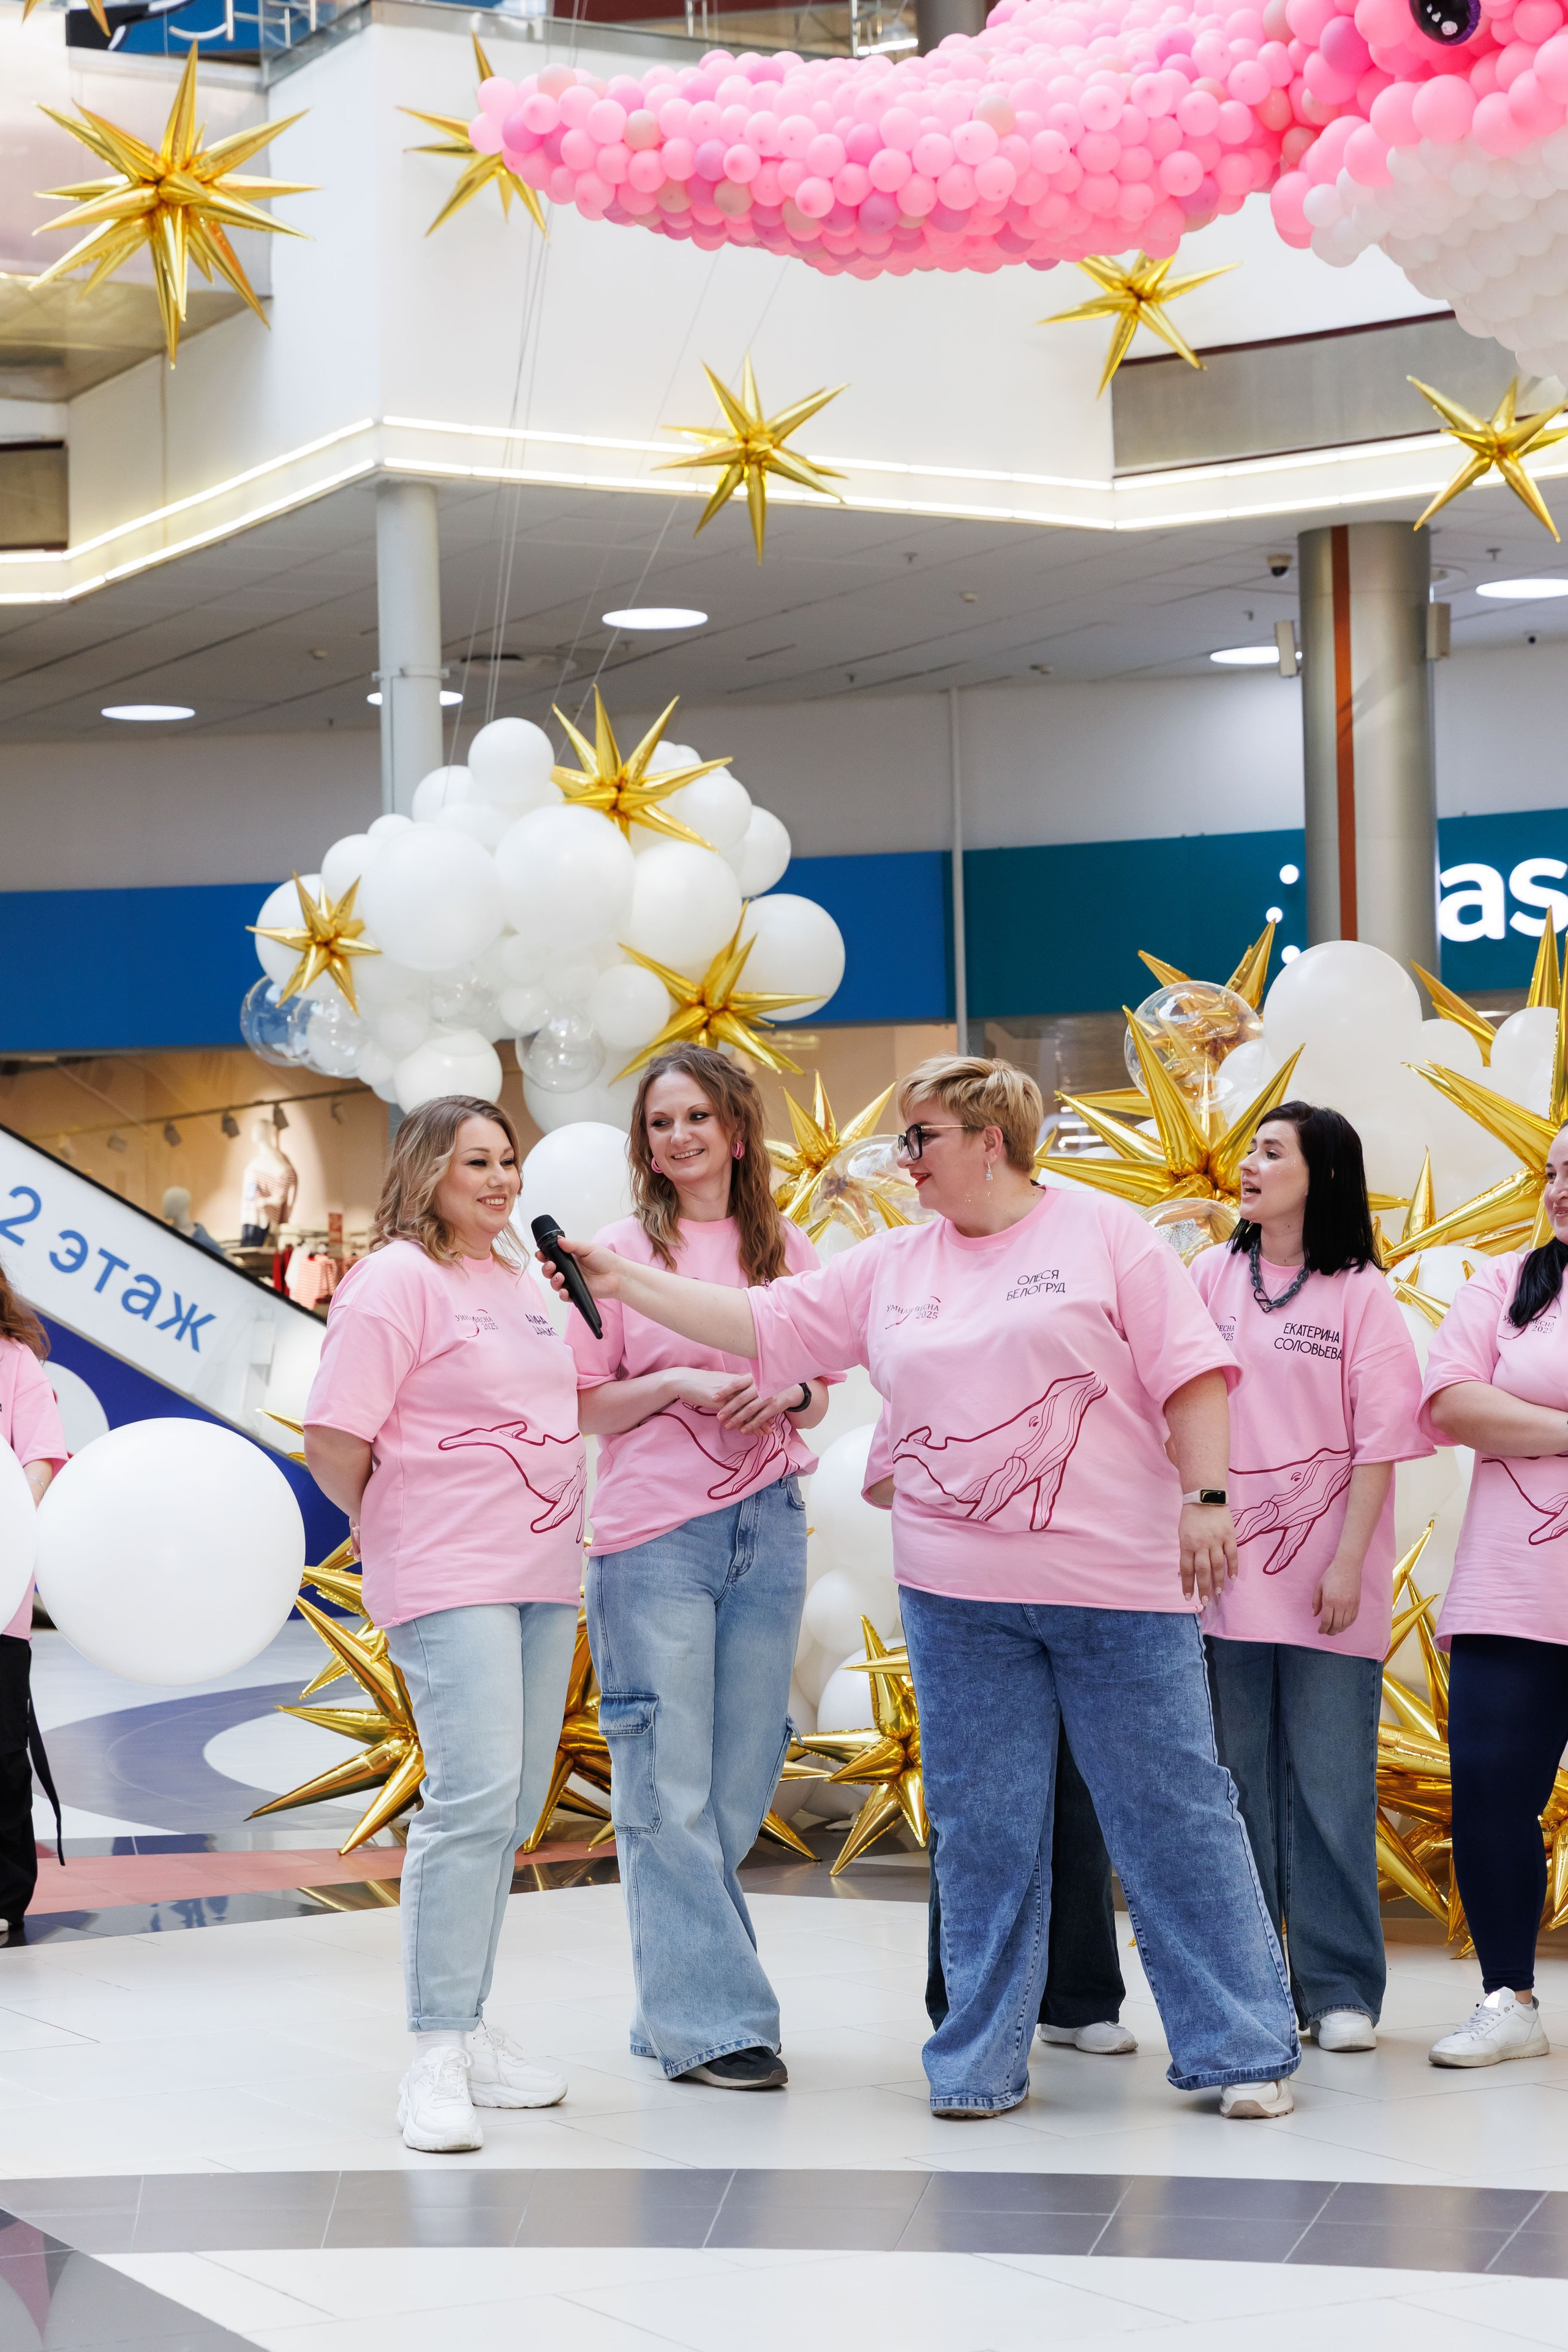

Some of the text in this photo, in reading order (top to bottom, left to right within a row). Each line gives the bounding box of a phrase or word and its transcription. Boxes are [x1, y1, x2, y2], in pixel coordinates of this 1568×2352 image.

[0, 1186, 217, 1352] 2 этаж
[1017, 1270, 1059, 1285] ОЛЕСЯ
[1006, 1283, 1066, 1301] БЕЛОГРУД
[916, 1311, 938, 1319] 2025
[1283, 1323, 1340, 1344] ЕКАТЕРИНА
[1532, 1325, 1554, 1334] 2025
[1274, 1338, 1342, 1361] СОЛОВЬЕВА
